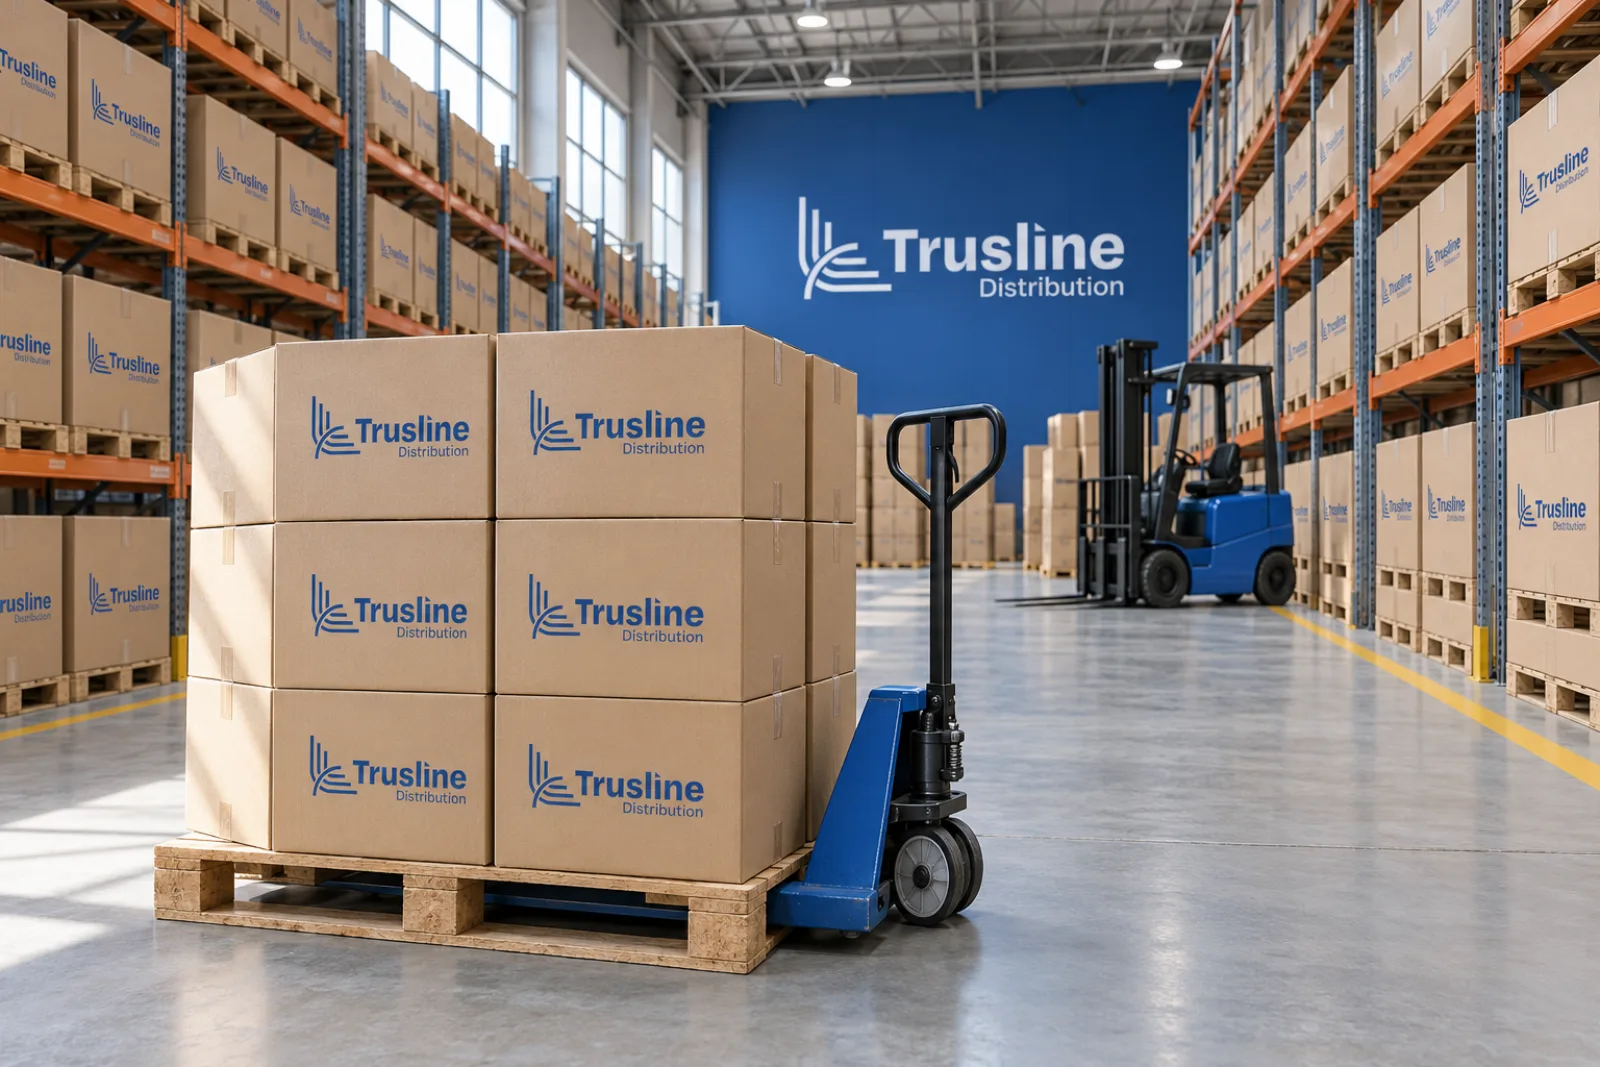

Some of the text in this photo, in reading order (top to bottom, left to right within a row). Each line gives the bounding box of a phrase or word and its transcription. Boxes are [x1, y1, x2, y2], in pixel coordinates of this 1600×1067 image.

[0, 48, 57, 89] Trusline
[111, 103, 161, 139] Trusline
[231, 165, 269, 195] Trusline
[1536, 146, 1590, 193] Trusline
[882, 221, 1125, 273] Trusline
[980, 276, 1124, 298] Distribution
[0, 333, 51, 356] rusline
[108, 352, 160, 376] Trusline
[355, 414, 470, 444] Trusline
[575, 409, 706, 441] Trusline
[397, 444, 470, 459] Distribution
[622, 441, 705, 456] Distribution
[1436, 495, 1466, 513] Trusline
[1535, 496, 1587, 519] Trusline
[110, 584, 160, 604] Trusline
[353, 595, 468, 625] Trusline
[575, 597, 705, 628] Trusline
[396, 625, 468, 640] Distribution
[622, 628, 704, 644] Distribution
[352, 759, 467, 790] Trusline
[575, 770, 705, 802] Trusline
[395, 790, 467, 805] Distribution
[622, 801, 704, 819] Distribution
